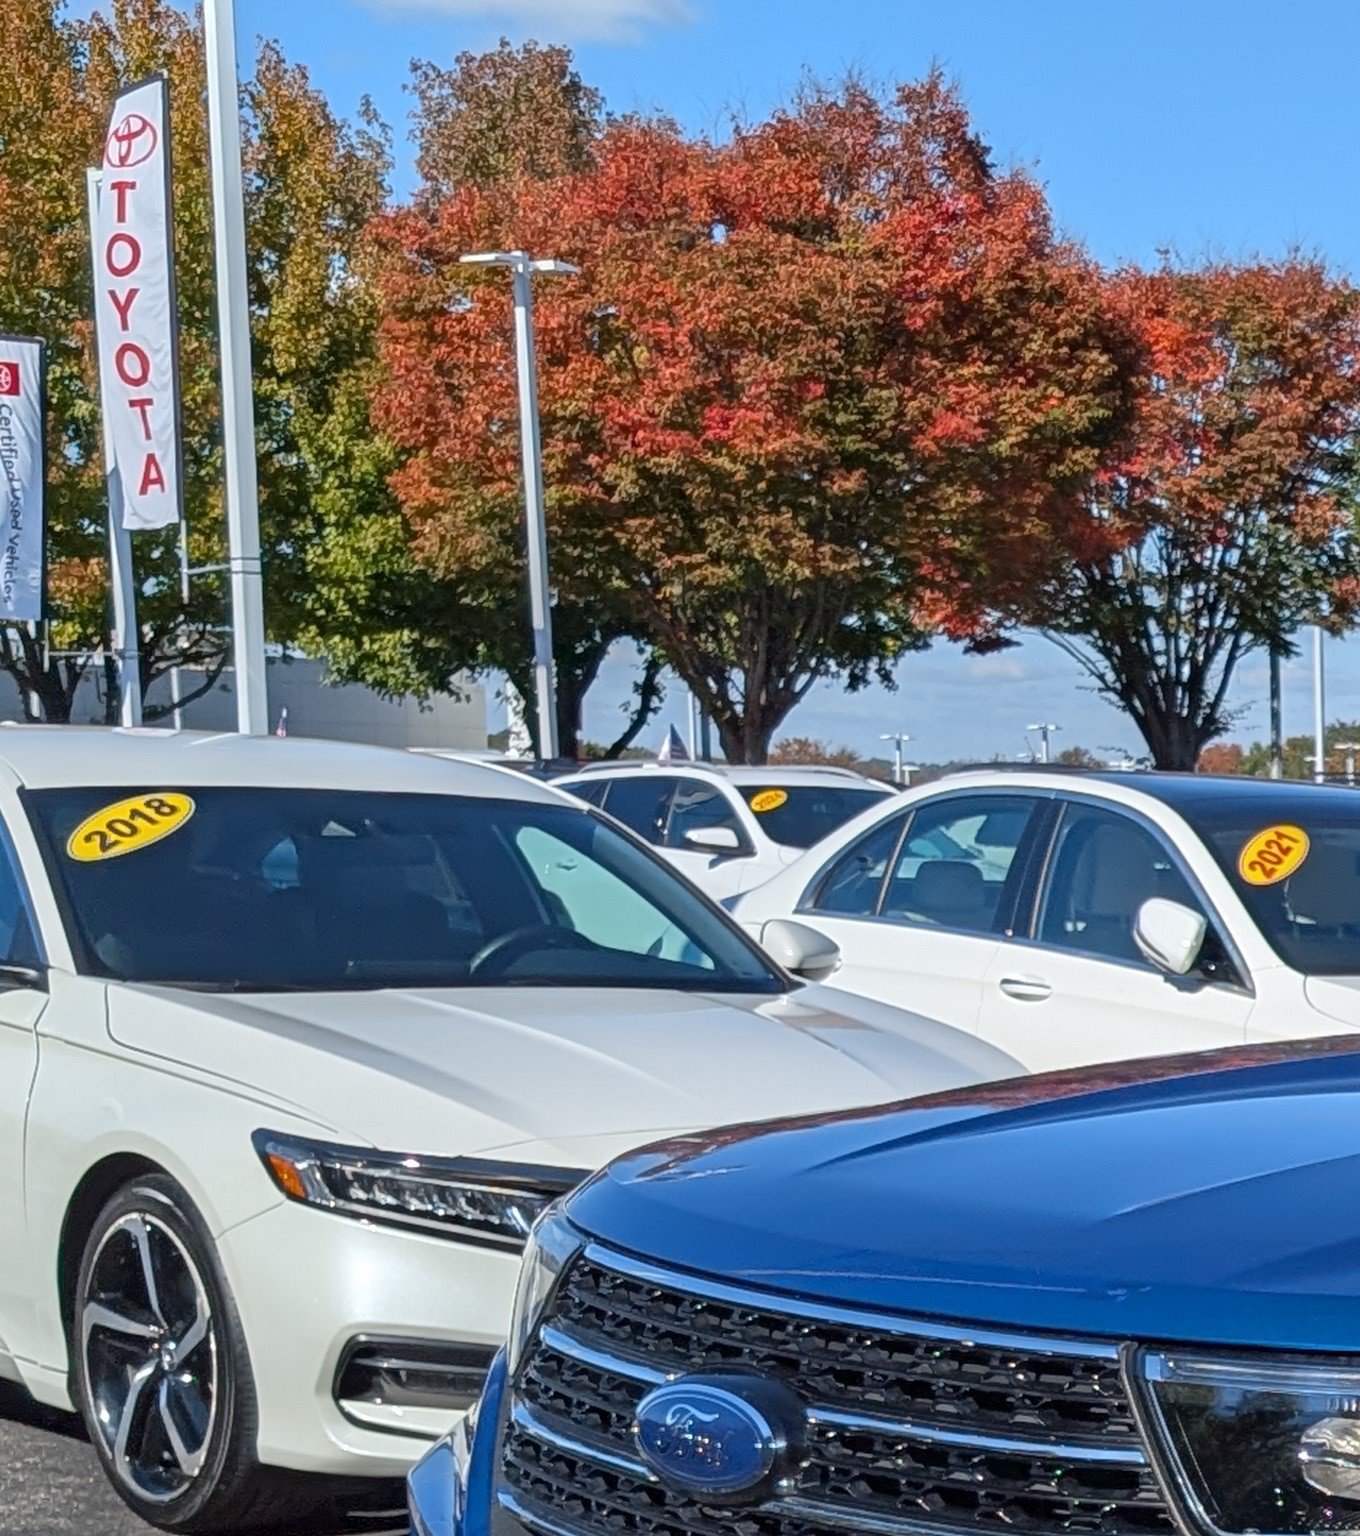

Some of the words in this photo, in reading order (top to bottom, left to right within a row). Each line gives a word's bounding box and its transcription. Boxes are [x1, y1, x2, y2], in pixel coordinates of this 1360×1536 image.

[106, 180, 165, 496] TOYOTA
[83, 798, 178, 853] 2018
[1248, 830, 1300, 880] 2021
